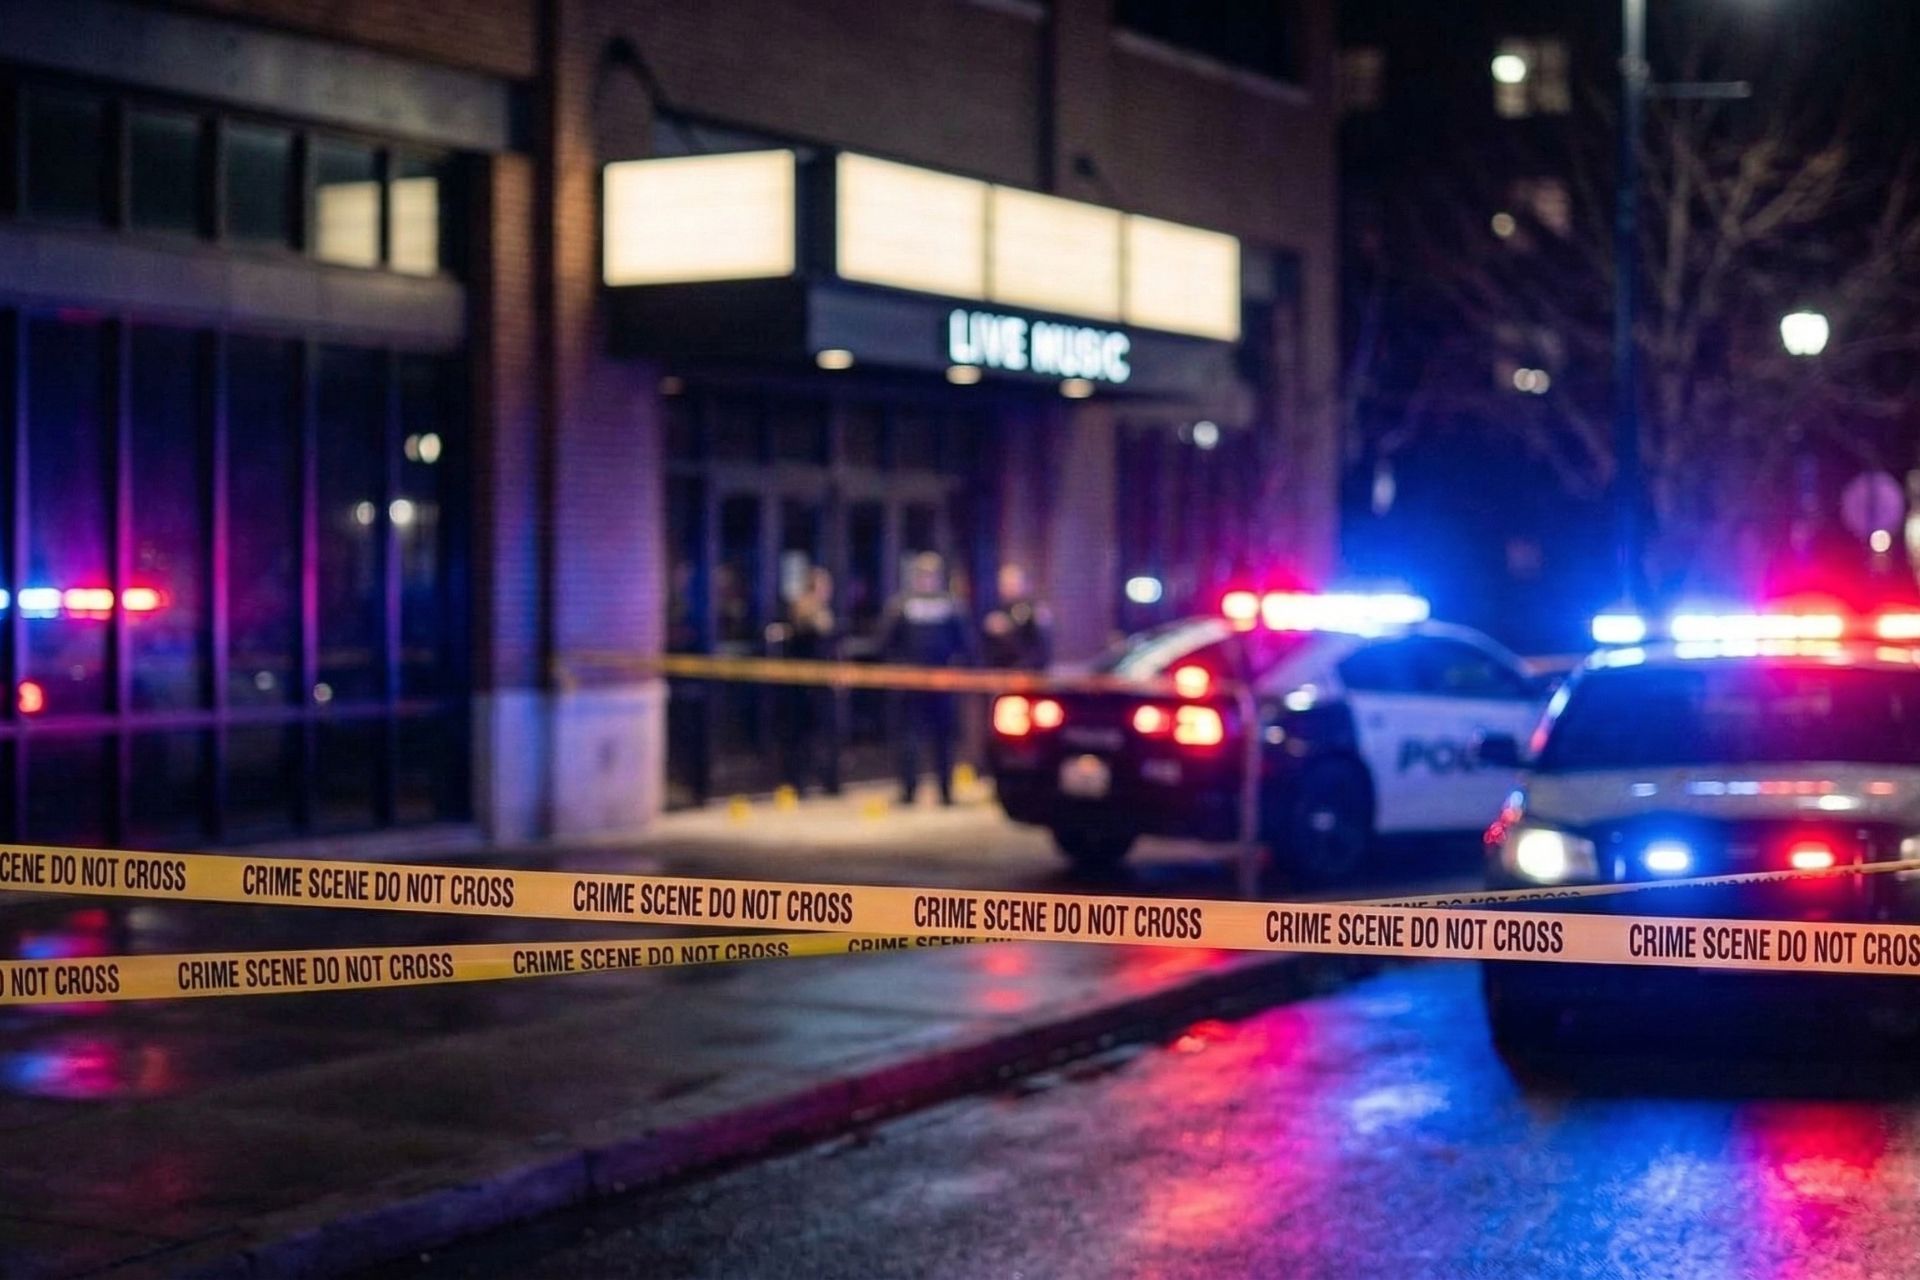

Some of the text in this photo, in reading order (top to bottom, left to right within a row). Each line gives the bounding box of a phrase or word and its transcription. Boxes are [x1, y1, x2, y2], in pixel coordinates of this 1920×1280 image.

[950, 309, 1130, 383] LIVE MUSIC
[0, 852, 185, 891] CENE DO NOT CROSS
[243, 865, 513, 908] CRIME SCENE DO NOT CROSS
[574, 881, 852, 924] CRIME SCENE DO NOT CROSS
[915, 896, 1201, 939] CRIME SCENE DO NOT CROSS
[1267, 911, 1563, 953] CRIME SCENE DO NOT CROSS
[1630, 924, 1920, 966] CRIME SCENE DO NOT CROS
[179, 953, 453, 989] CRIME SCENE DO NOT CROSS
[514, 942, 789, 974] CRIME SCENE DO NOT CROSS
[12, 967, 48, 996] NOT
[55, 964, 119, 995] CROSS
